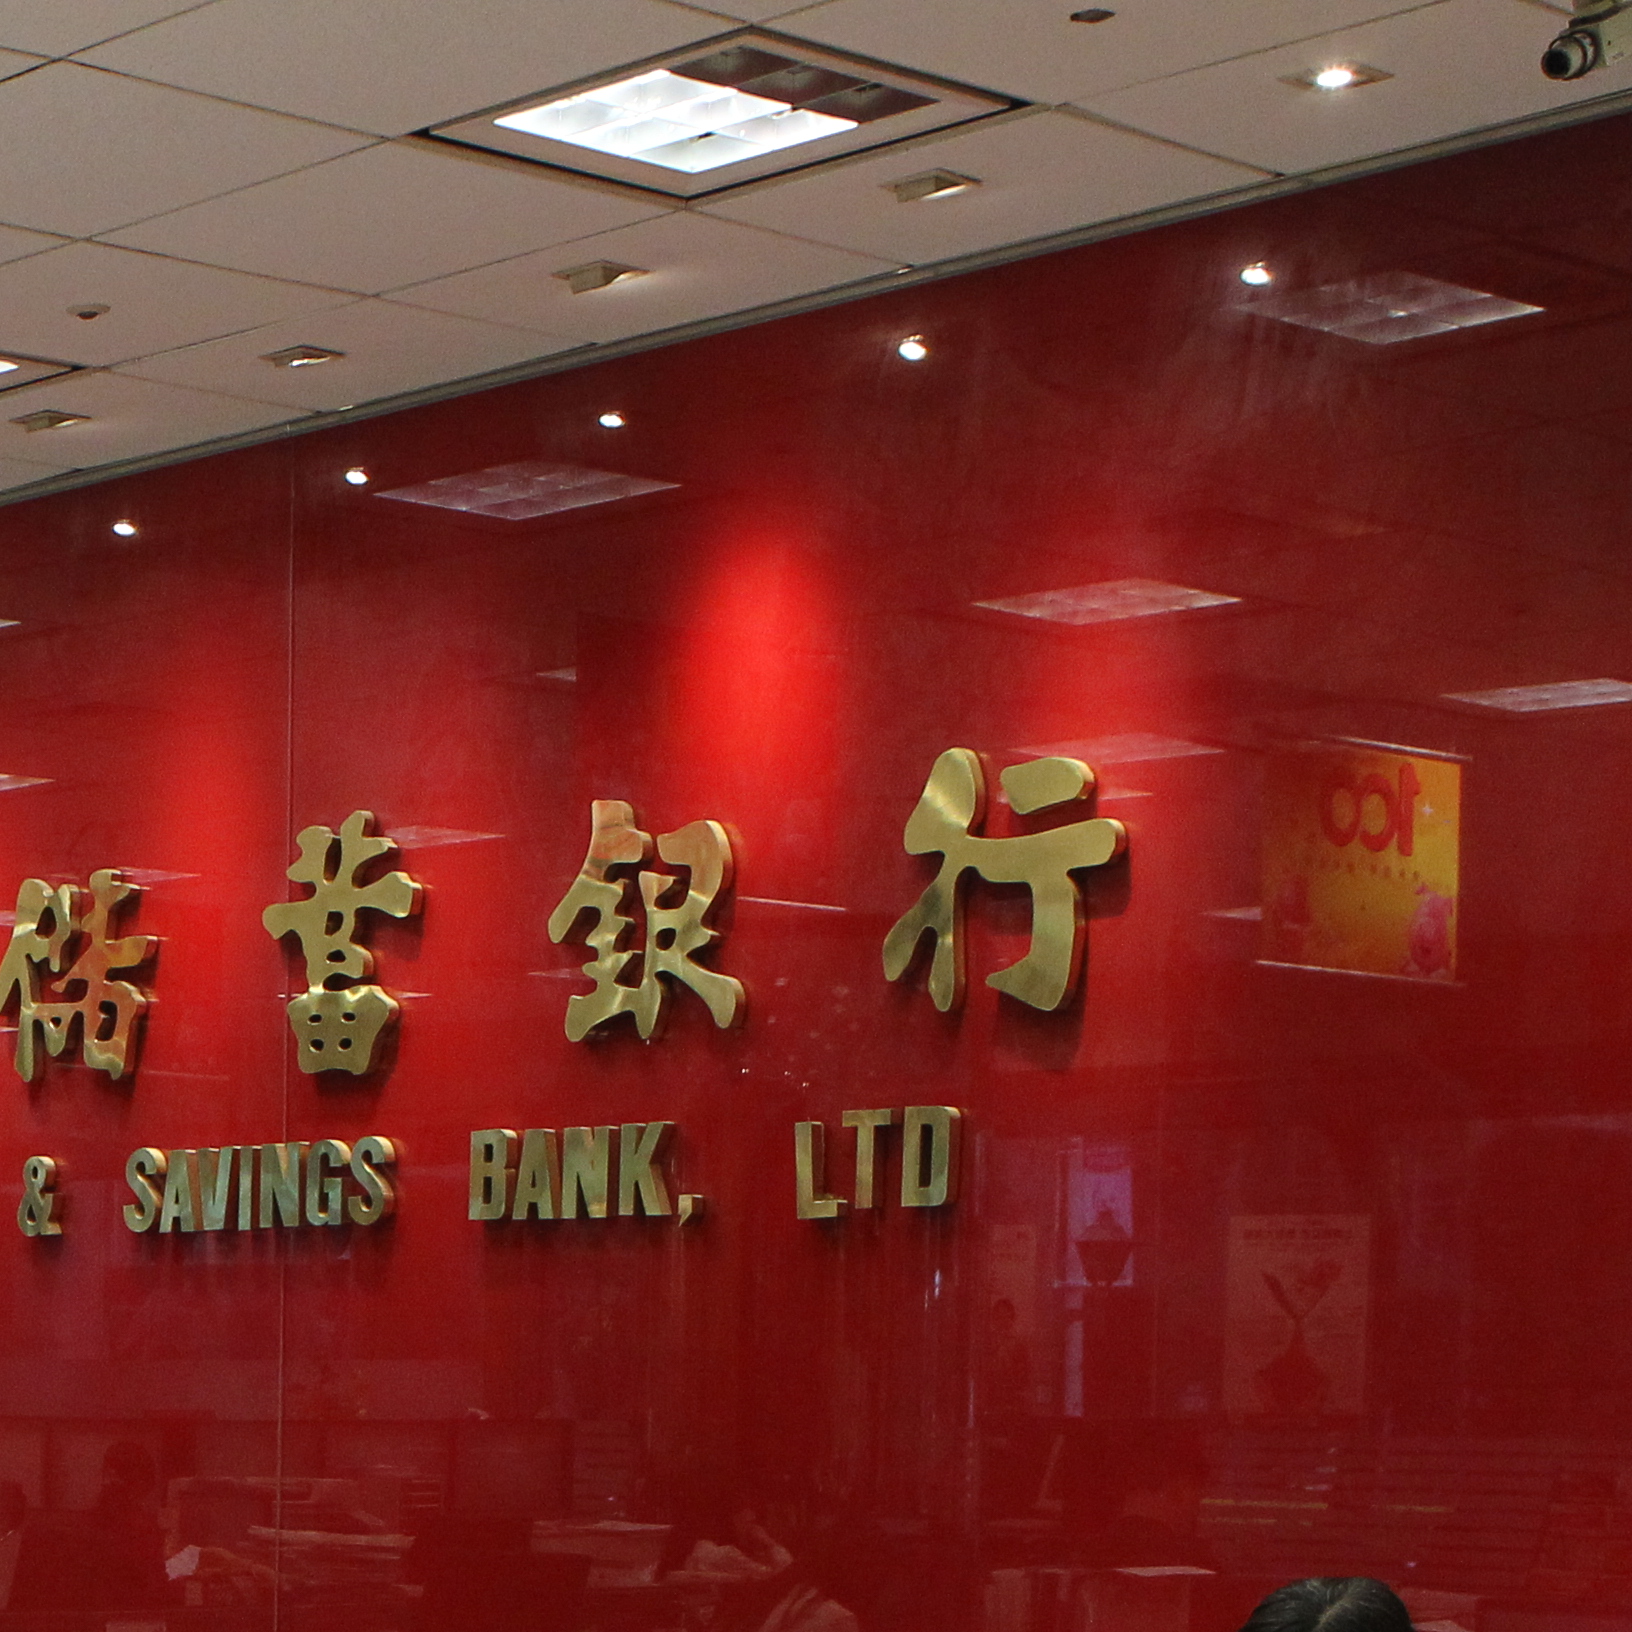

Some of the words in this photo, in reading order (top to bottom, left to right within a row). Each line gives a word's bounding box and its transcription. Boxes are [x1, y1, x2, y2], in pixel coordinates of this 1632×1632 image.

[17, 1155, 62, 1237] &
[123, 1135, 396, 1233] SAVINGS
[793, 1104, 963, 1219] LTD
